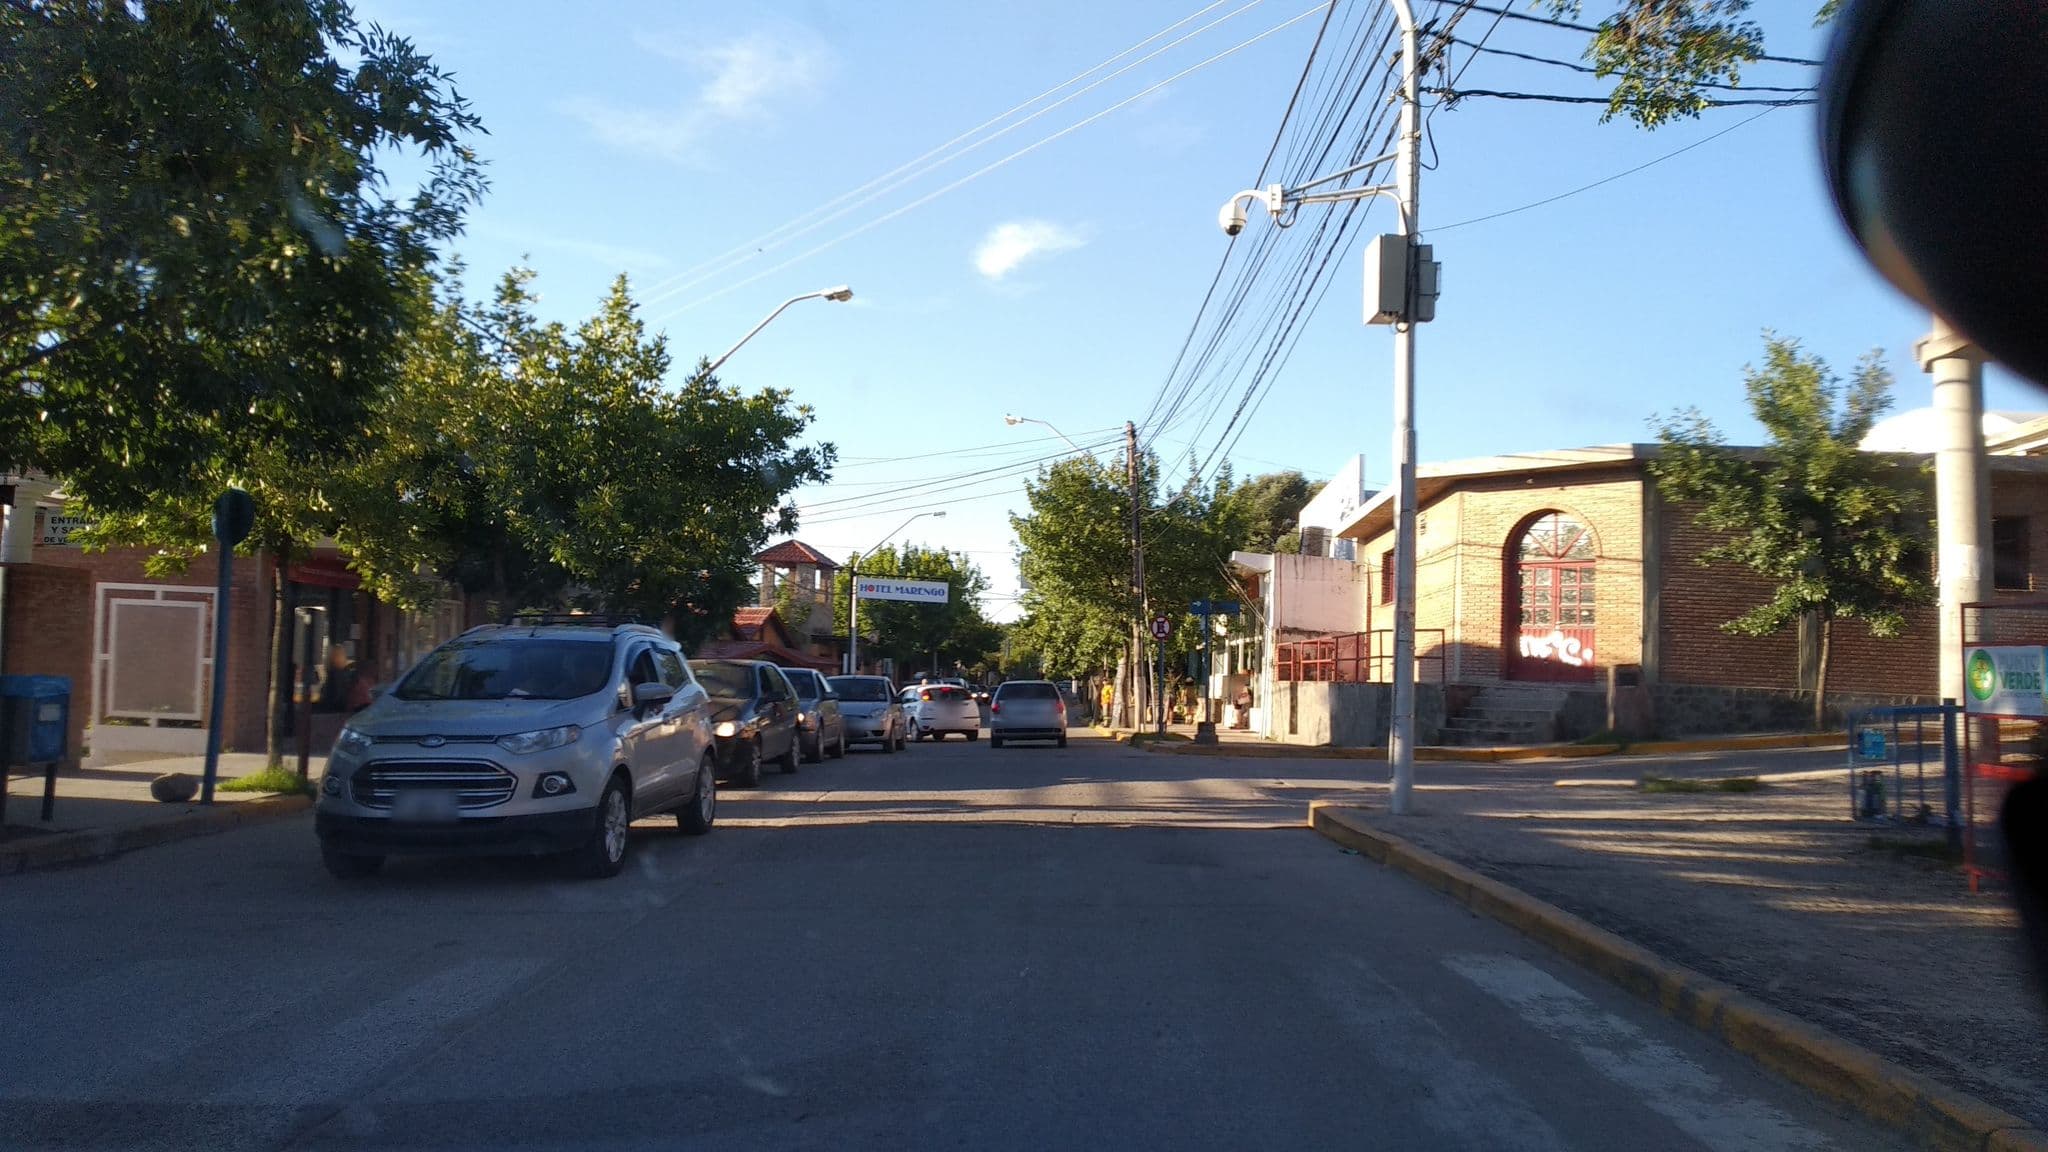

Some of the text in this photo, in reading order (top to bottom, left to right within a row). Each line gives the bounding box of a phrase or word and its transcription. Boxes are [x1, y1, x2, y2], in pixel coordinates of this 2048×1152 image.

[51, 526, 58, 534] Y
[859, 583, 945, 597] HOTEL MARENGO
[1999, 671, 2042, 690] VERDE
